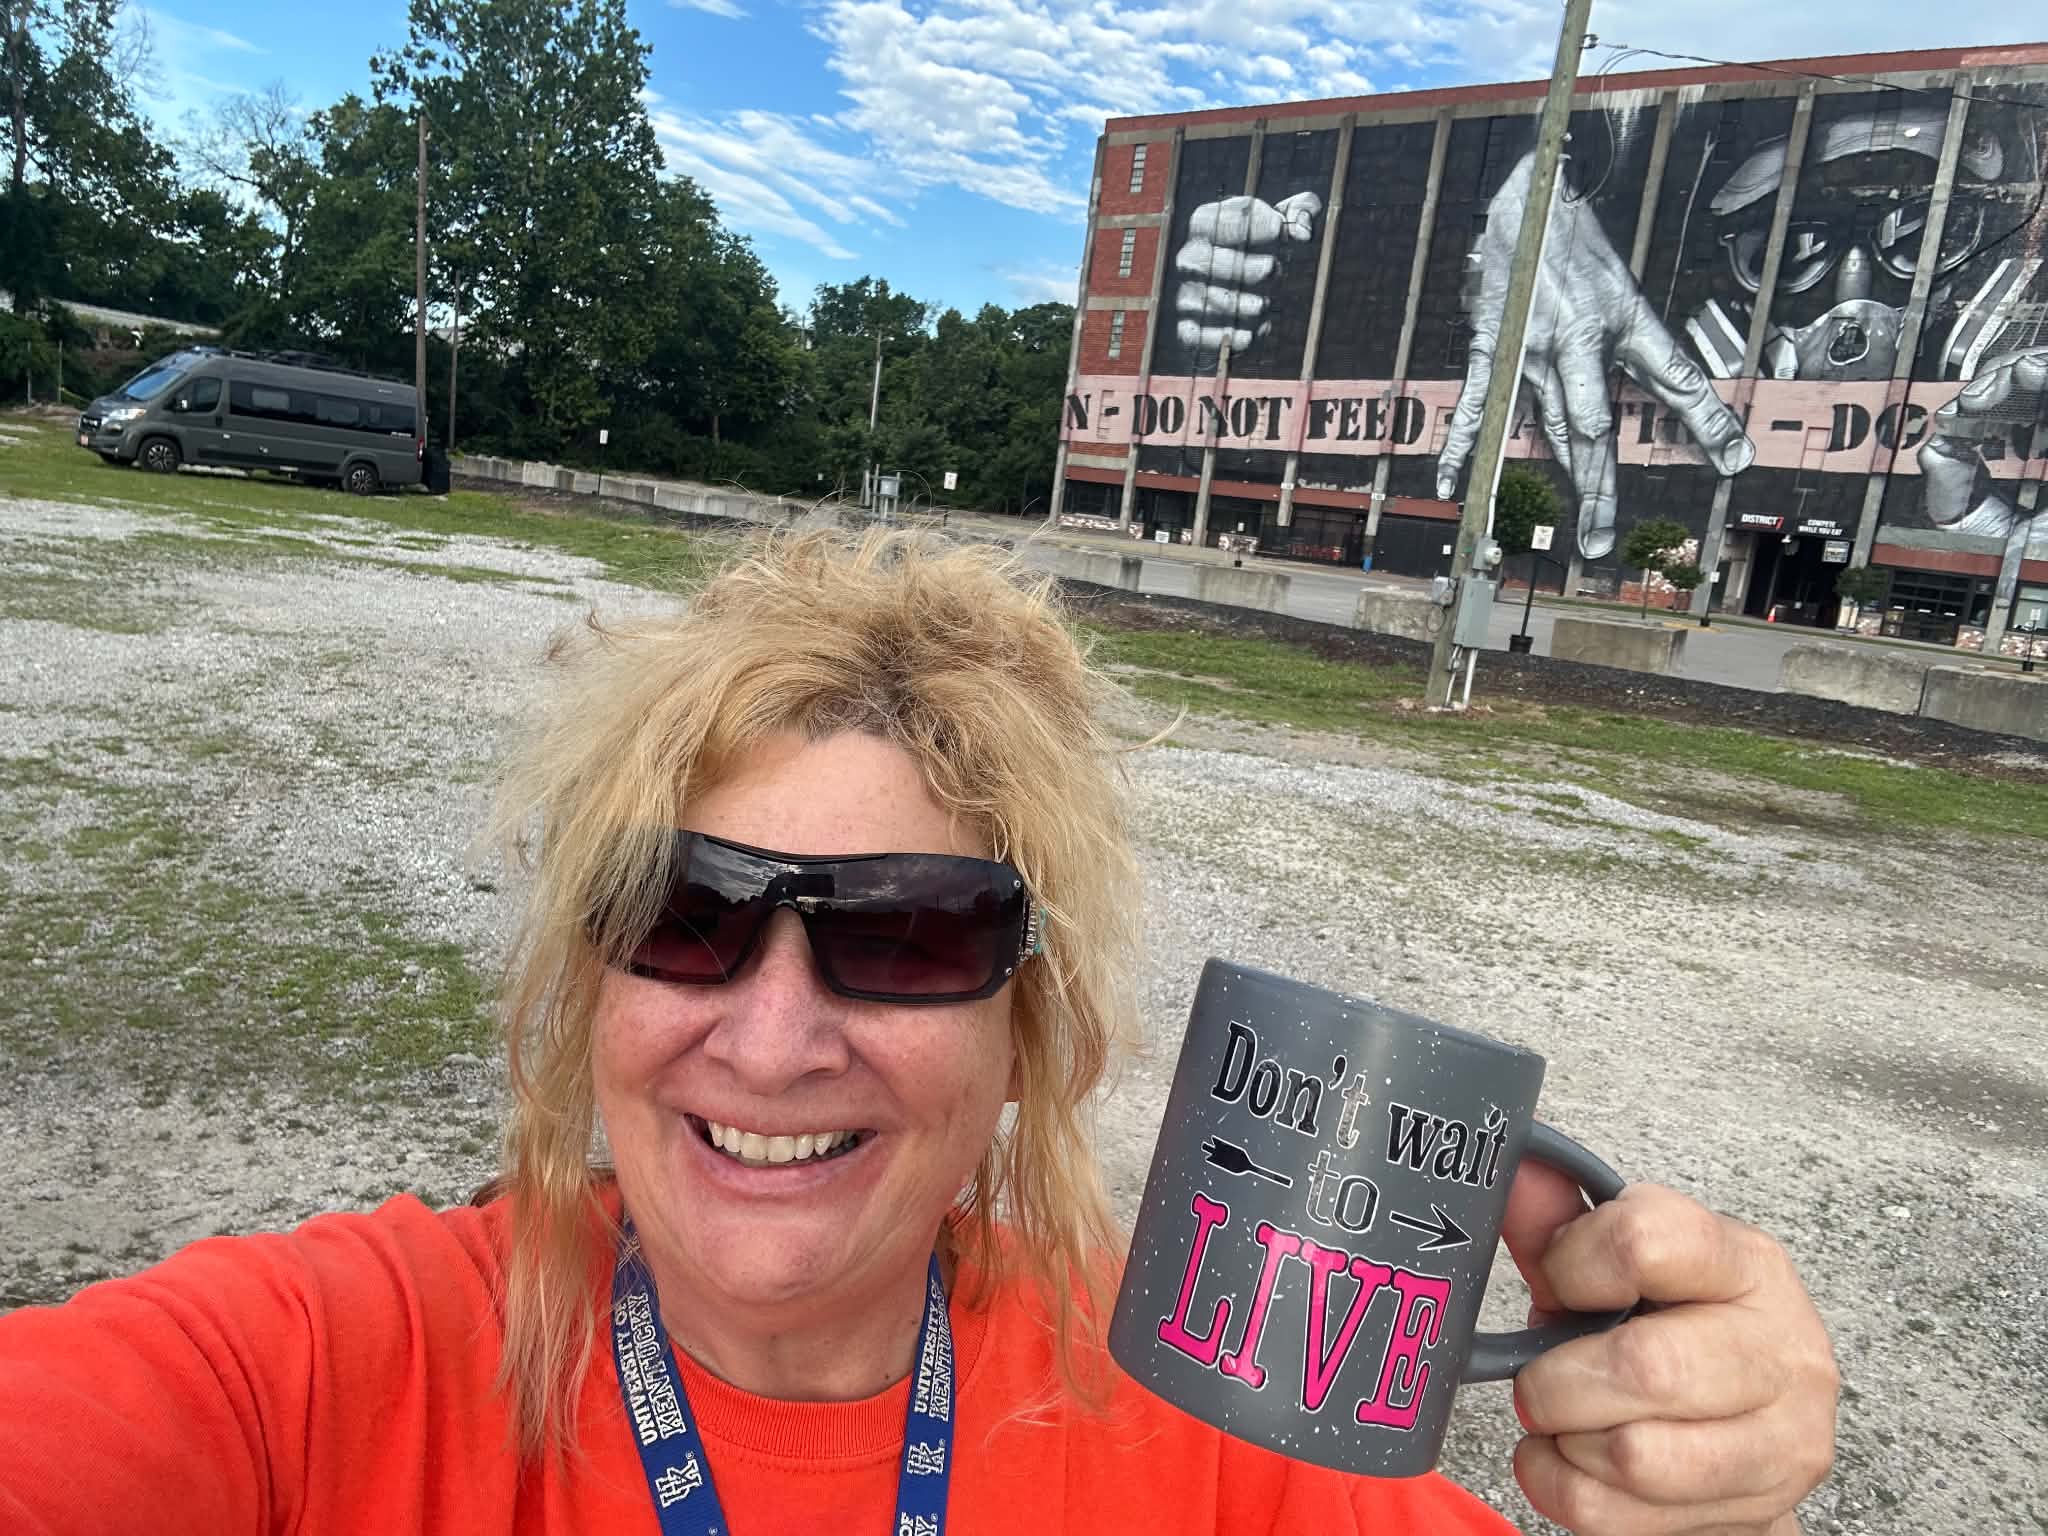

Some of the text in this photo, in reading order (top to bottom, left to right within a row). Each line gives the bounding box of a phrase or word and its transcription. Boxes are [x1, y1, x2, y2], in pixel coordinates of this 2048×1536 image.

[1132, 394, 1185, 437] DO
[1196, 394, 1293, 441] NOT
[1307, 396, 1426, 445] FEED
[1741, 513, 1778, 526] DISTRICT
[1211, 1020, 1507, 1190] Don't wait
[1305, 1151, 1381, 1234] to
[627, 1292, 687, 1440] KENTUCKY
[914, 1301, 939, 1413] UNIVERSITY
[1157, 1191, 1452, 1431] LIVE
[617, 1332, 659, 1446] UNIVERSITY
